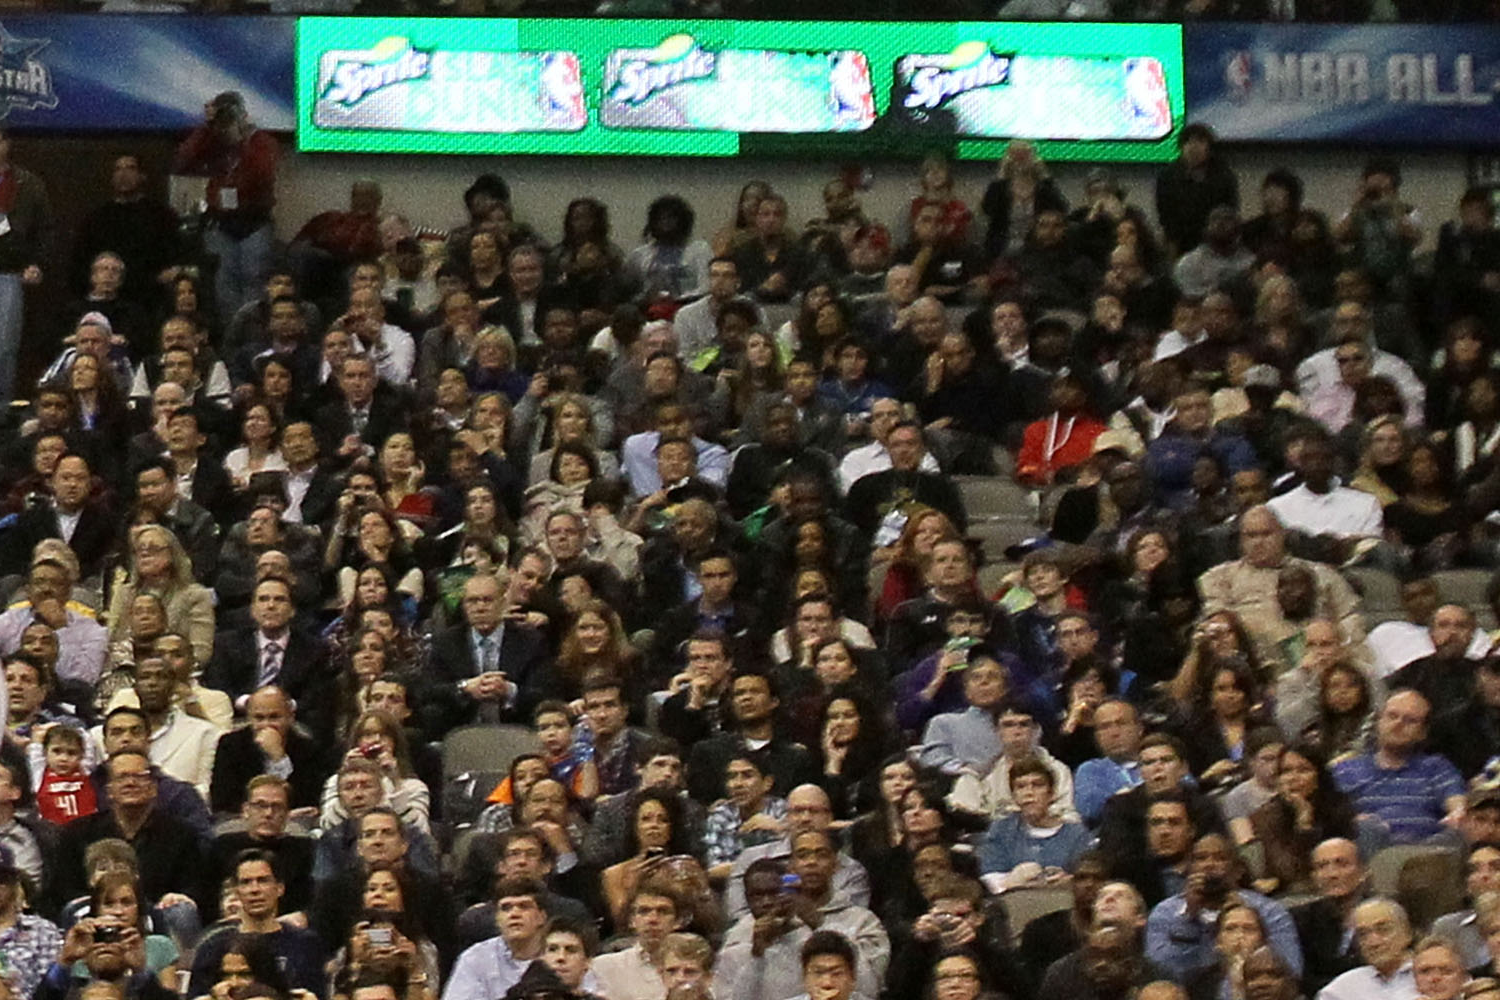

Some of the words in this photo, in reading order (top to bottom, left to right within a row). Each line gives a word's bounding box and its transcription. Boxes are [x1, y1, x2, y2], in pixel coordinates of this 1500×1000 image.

[323, 46, 429, 105] Sprite
[610, 46, 716, 105] Sprite
[903, 52, 1011, 110] Sprite
[1263, 52, 1370, 103] NBA
[1386, 53, 1500, 106] ALL
[55, 793, 79, 816] 41
